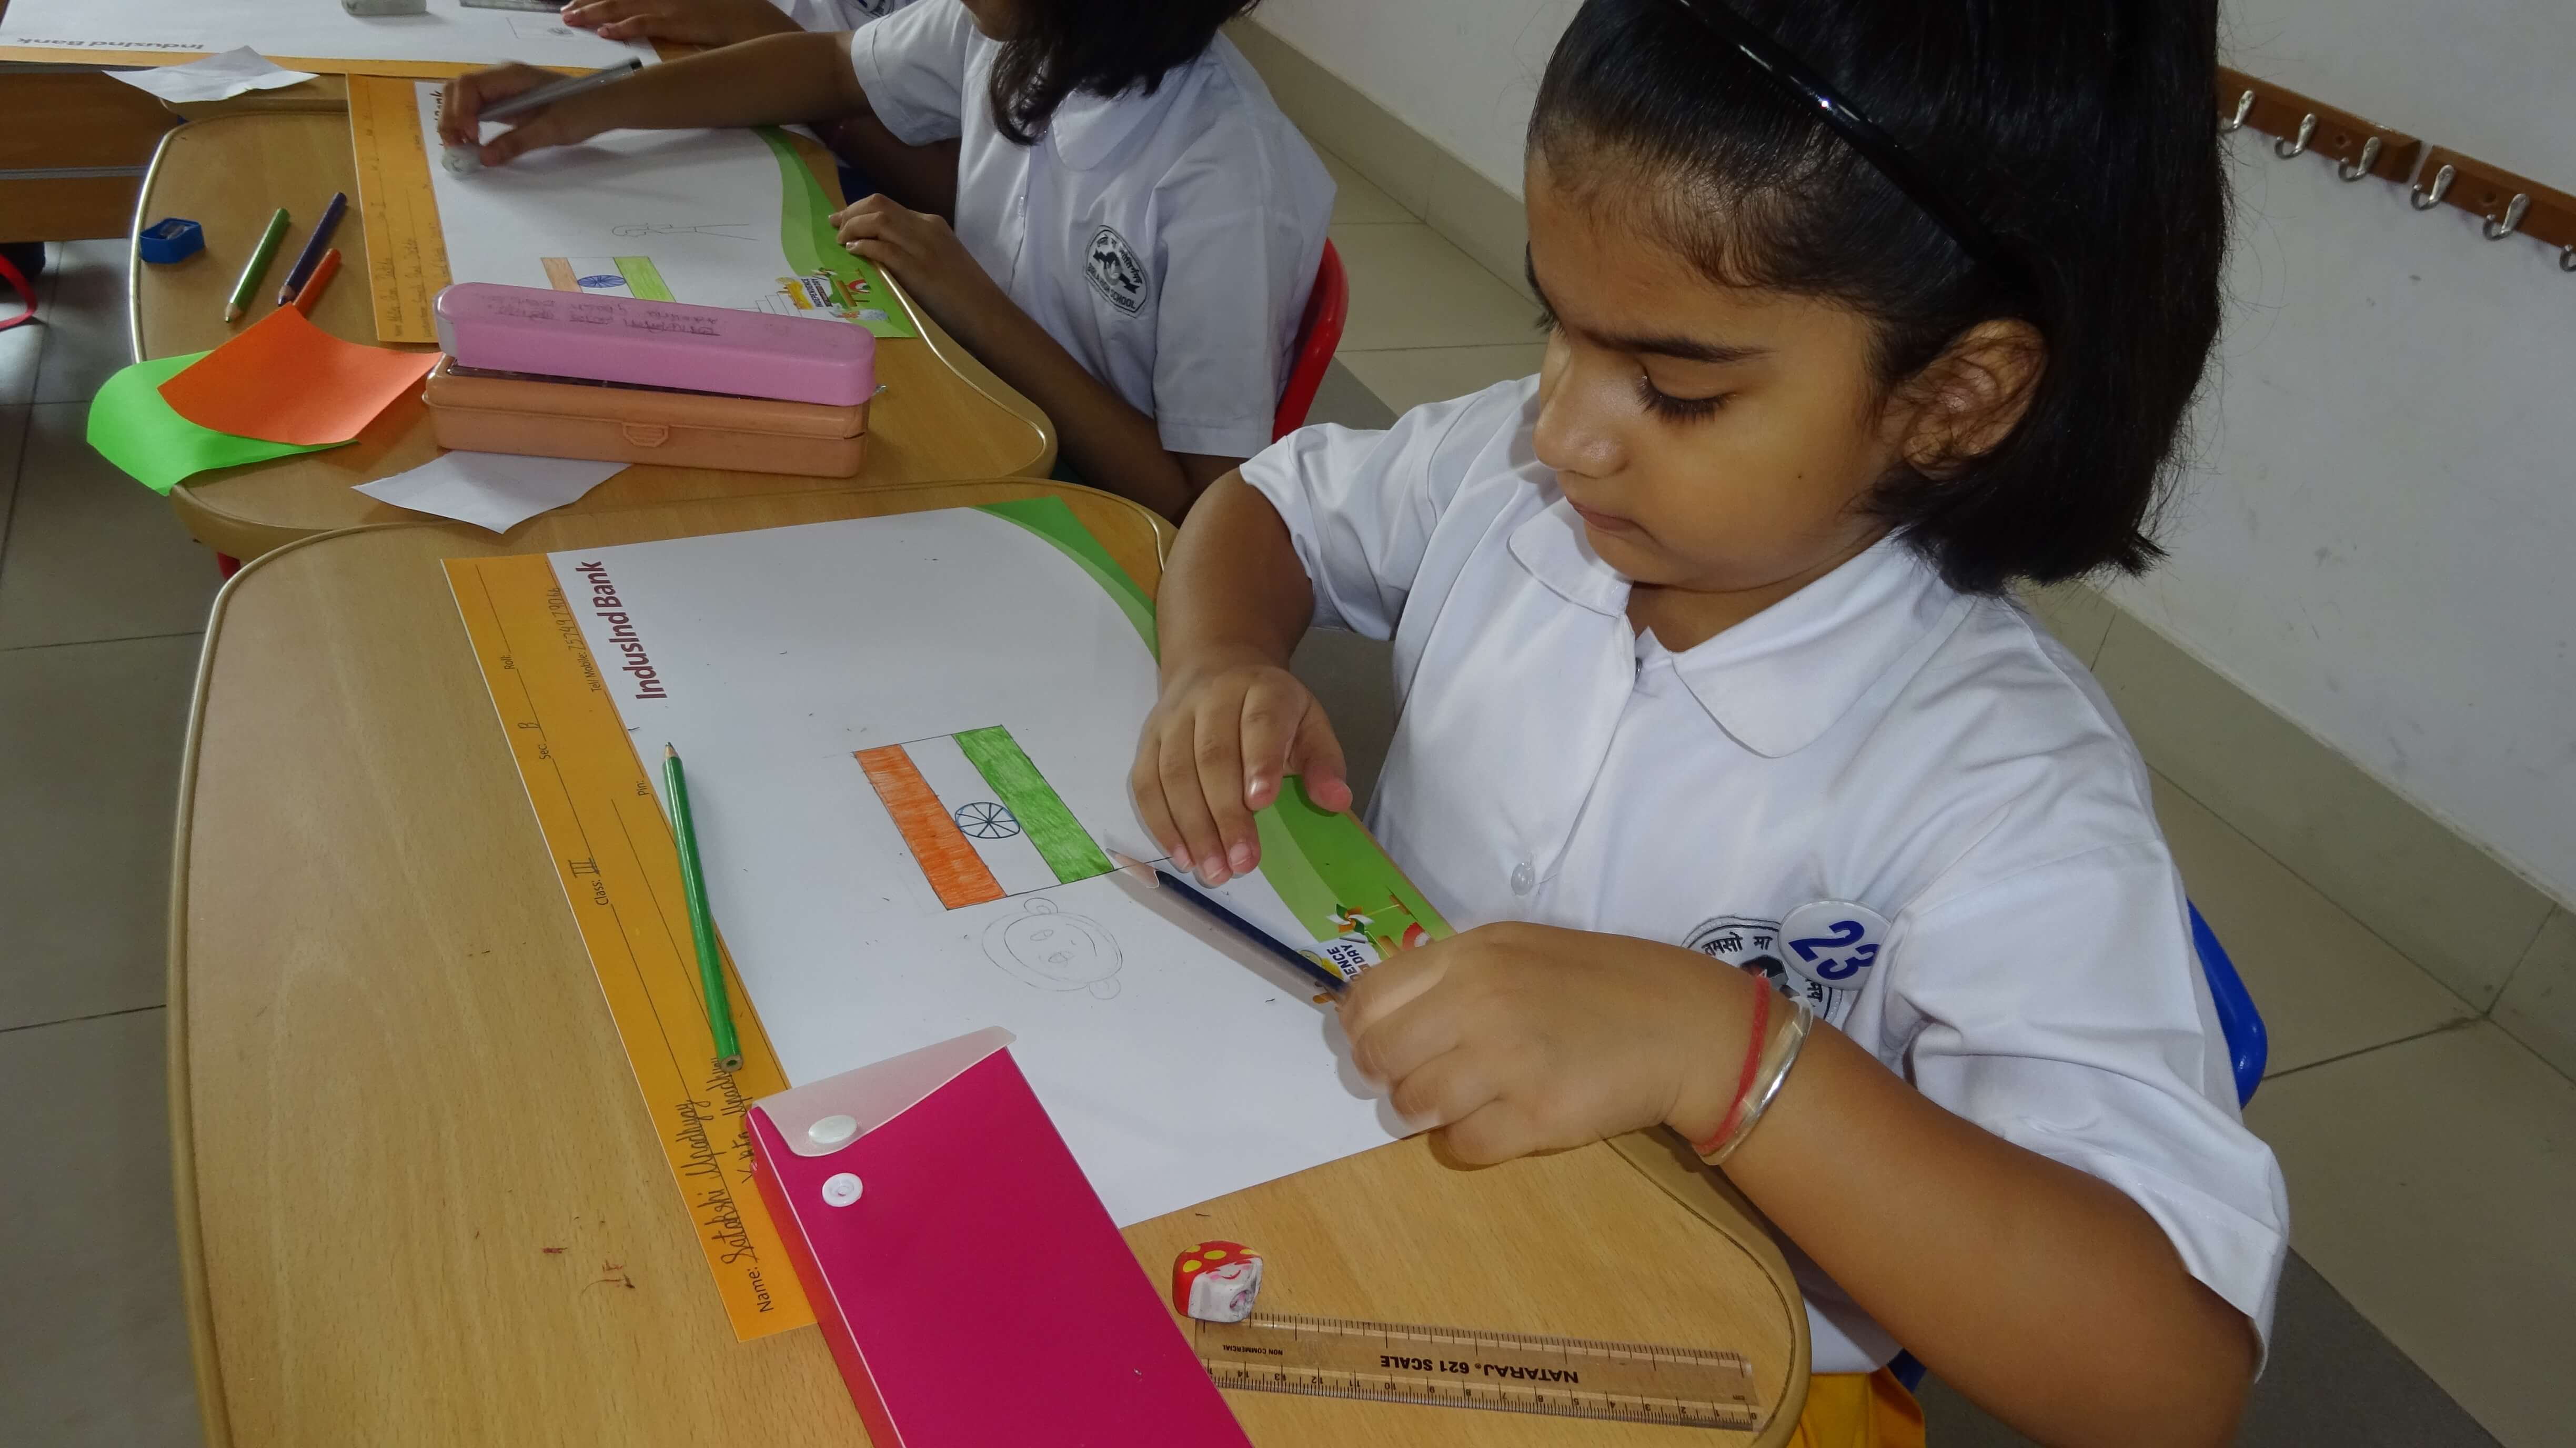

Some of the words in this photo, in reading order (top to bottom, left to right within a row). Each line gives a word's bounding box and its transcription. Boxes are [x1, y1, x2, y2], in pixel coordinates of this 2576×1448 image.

[17, 37, 85, 46] Bank
[88, 41, 205, 49] IndusInd
[1110, 289, 1135, 309] SCHOOL
[576, 561, 623, 608] Bank
[501, 655, 515, 670] Roll:
[596, 612, 667, 699] IndusInd
[636, 780, 649, 796] Pin:
[592, 879, 609, 906] Class:
[1753, 936, 1773, 950] मा
[1789, 921, 1881, 980] 23
[1341, 944, 1365, 964] DAY
[748, 1266, 774, 1313] Name:
[1223, 1344, 1266, 1355] COMMERCIAL
[1381, 1355, 1433, 1371] SCALE
[1440, 1360, 1470, 1374] 621
[1312, 1376, 1324, 1384] 12
